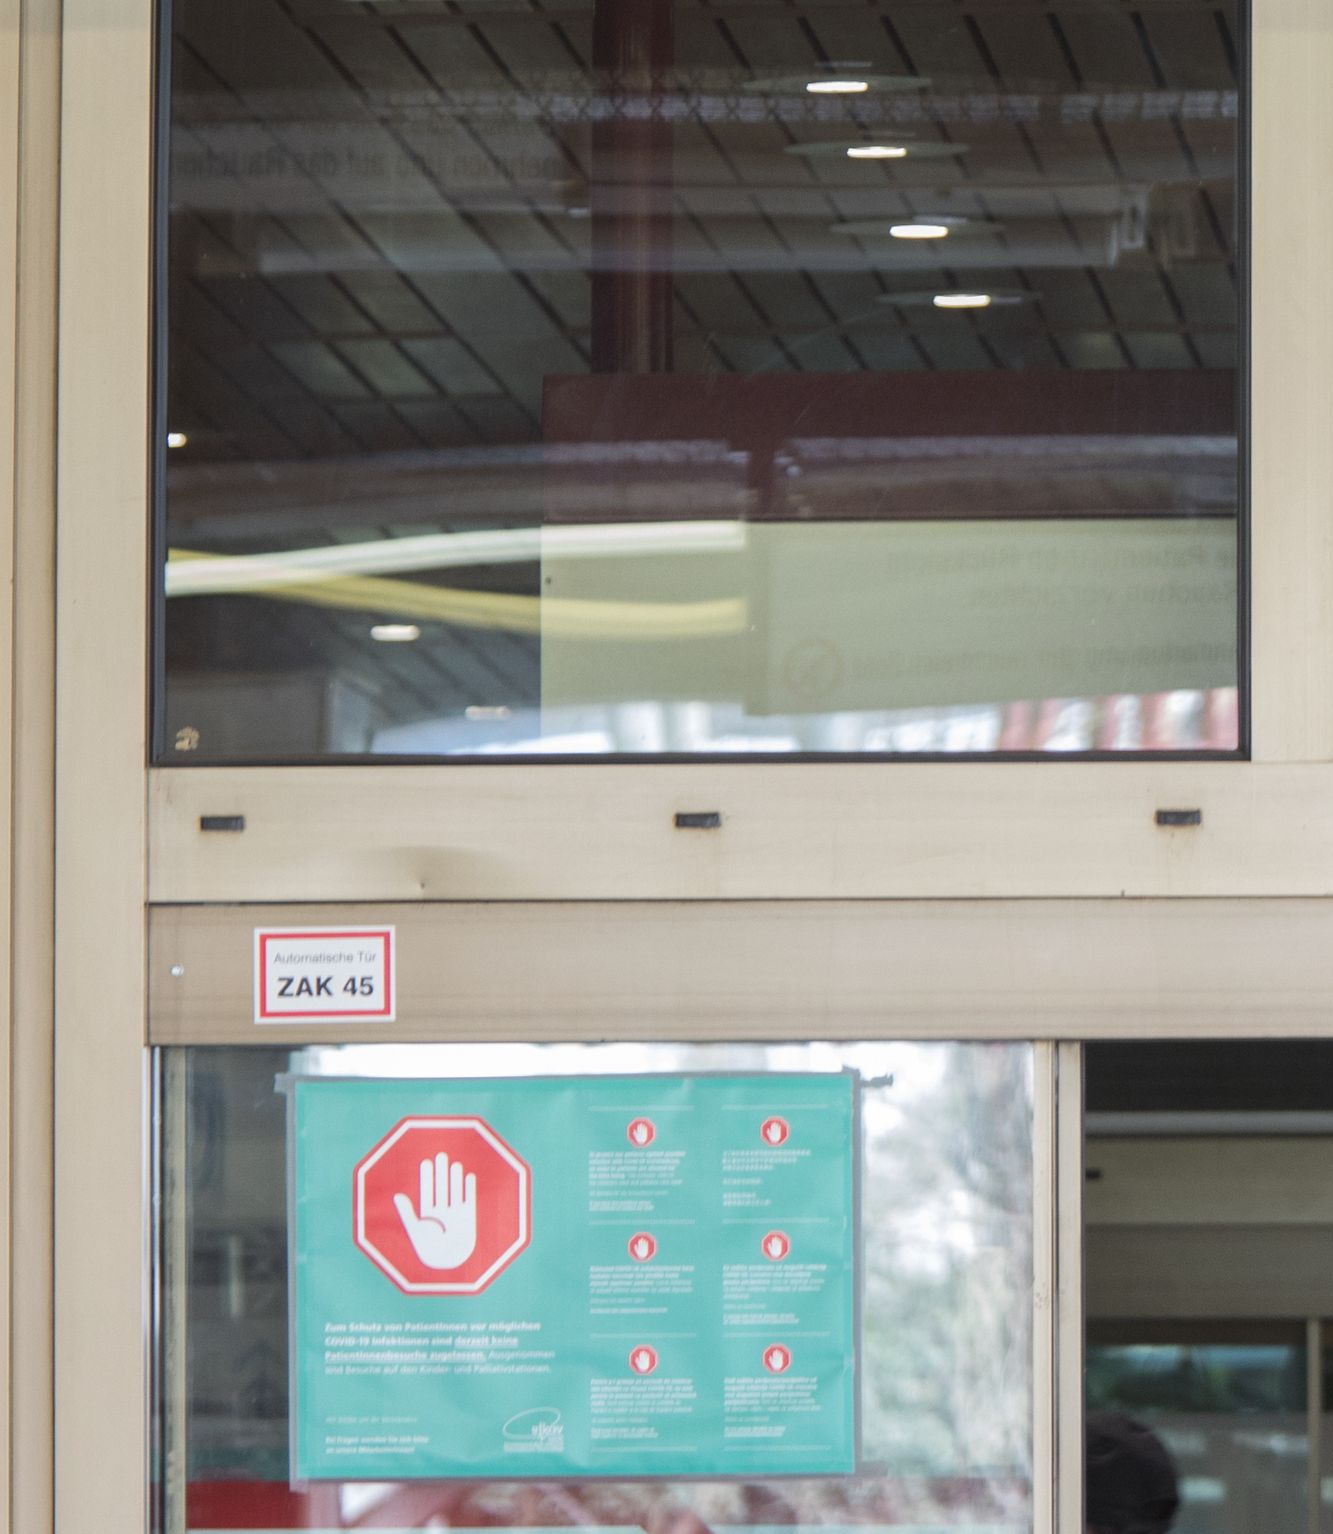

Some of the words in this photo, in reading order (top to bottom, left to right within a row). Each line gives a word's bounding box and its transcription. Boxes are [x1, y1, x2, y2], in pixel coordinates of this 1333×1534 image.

[274, 951, 354, 965] Automatische
[357, 951, 376, 963] Tür
[276, 976, 334, 998] ZAK
[342, 976, 374, 997] 45
